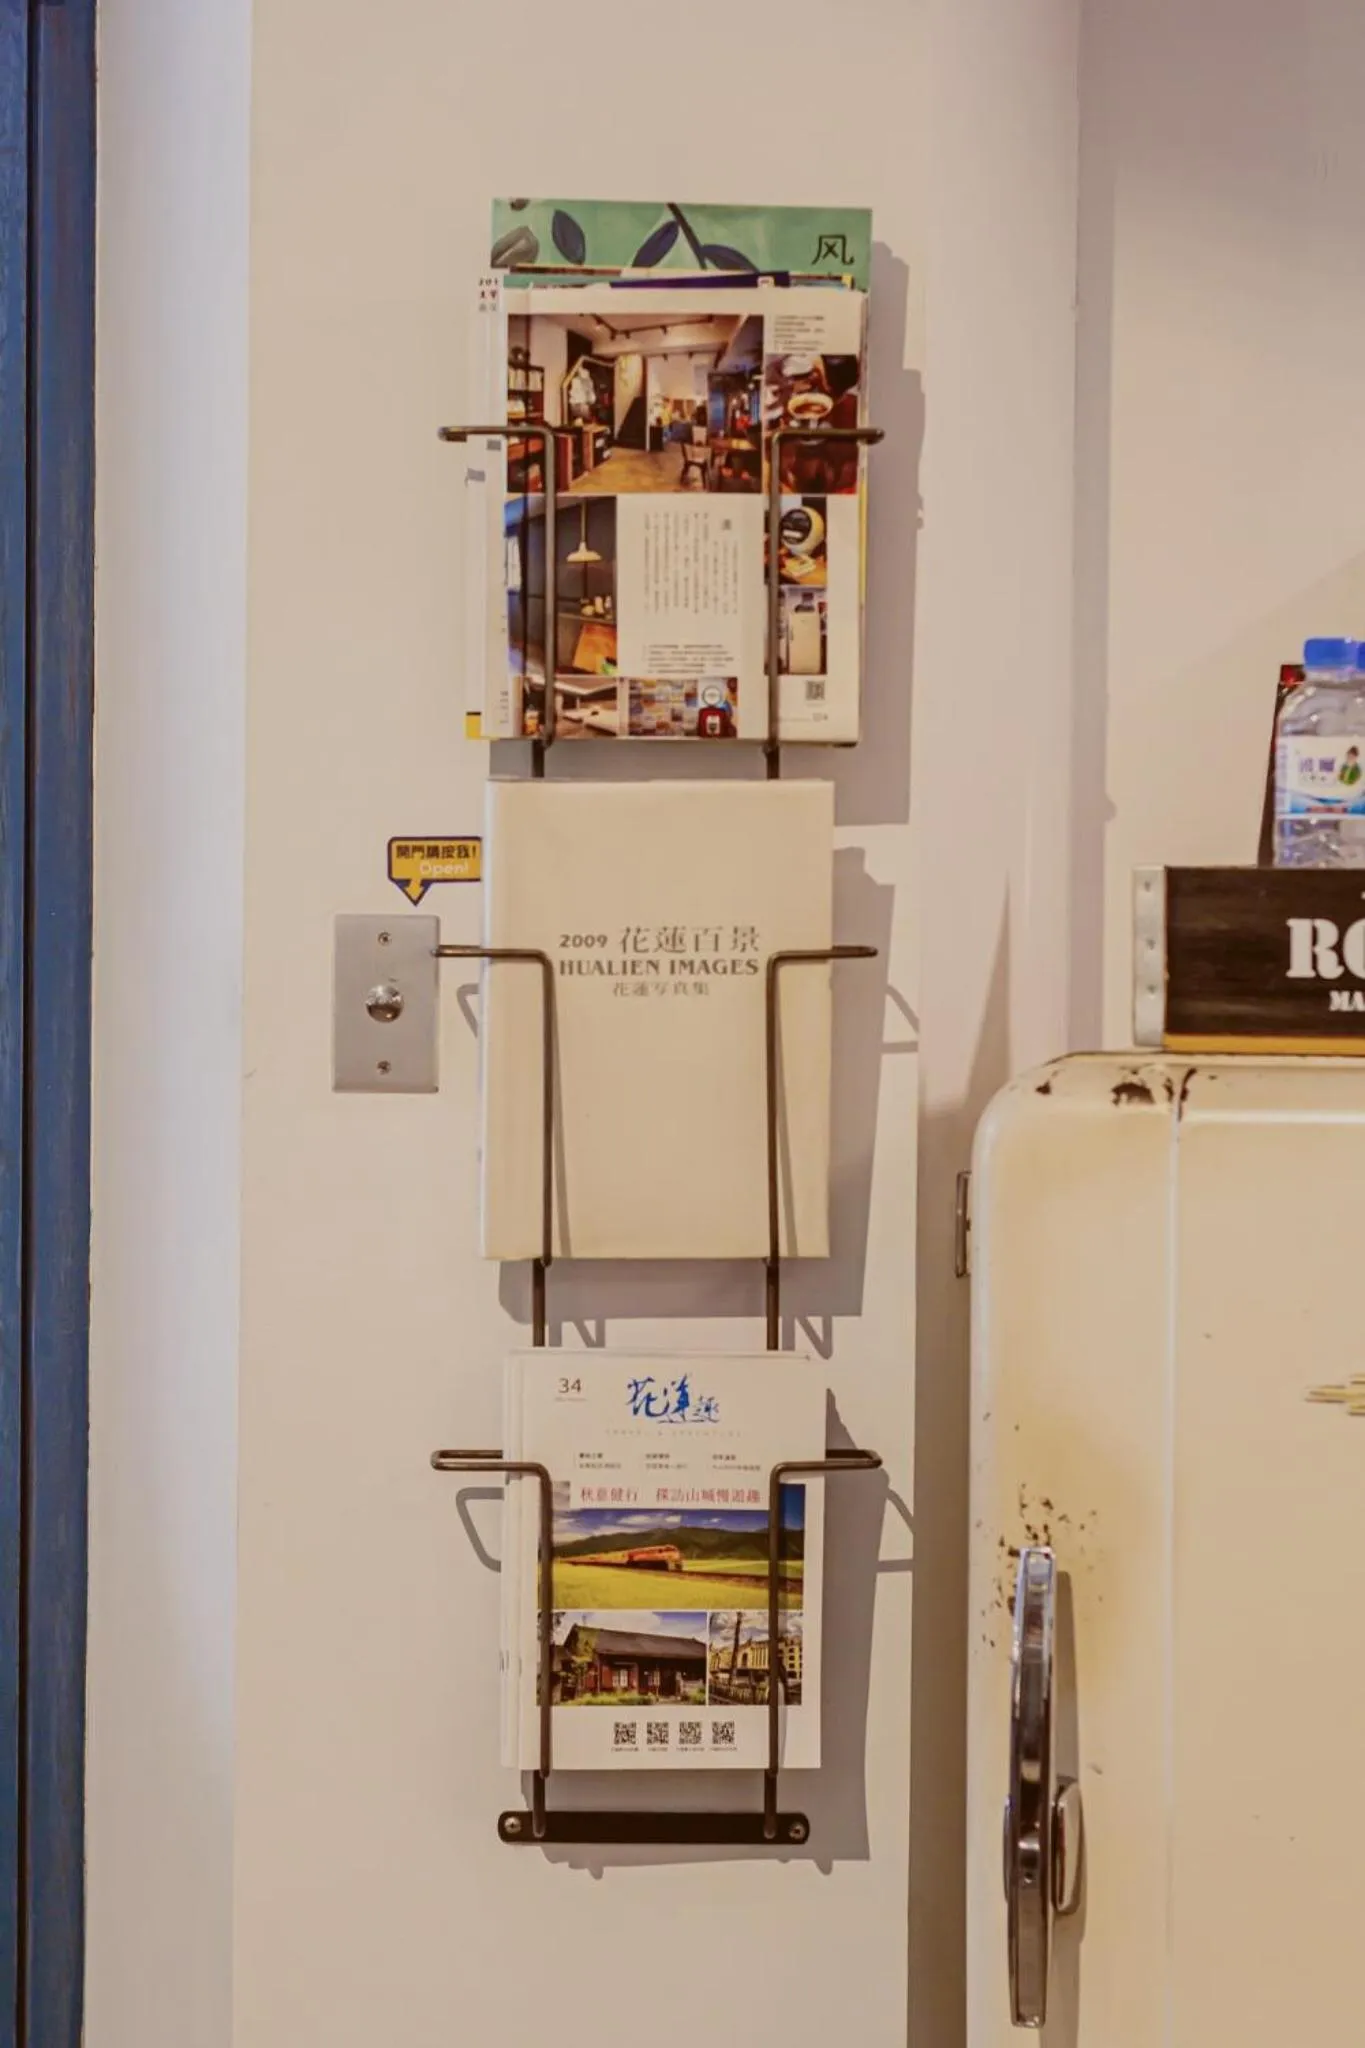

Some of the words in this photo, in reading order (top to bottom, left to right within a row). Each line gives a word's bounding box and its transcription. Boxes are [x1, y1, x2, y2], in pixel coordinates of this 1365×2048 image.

[559, 933, 608, 949] 2009
[620, 925, 760, 954] 花蓮百景
[559, 958, 660, 977] HUALIEN
[669, 957, 760, 977] IMAGES
[558, 1377, 582, 1394] 34
